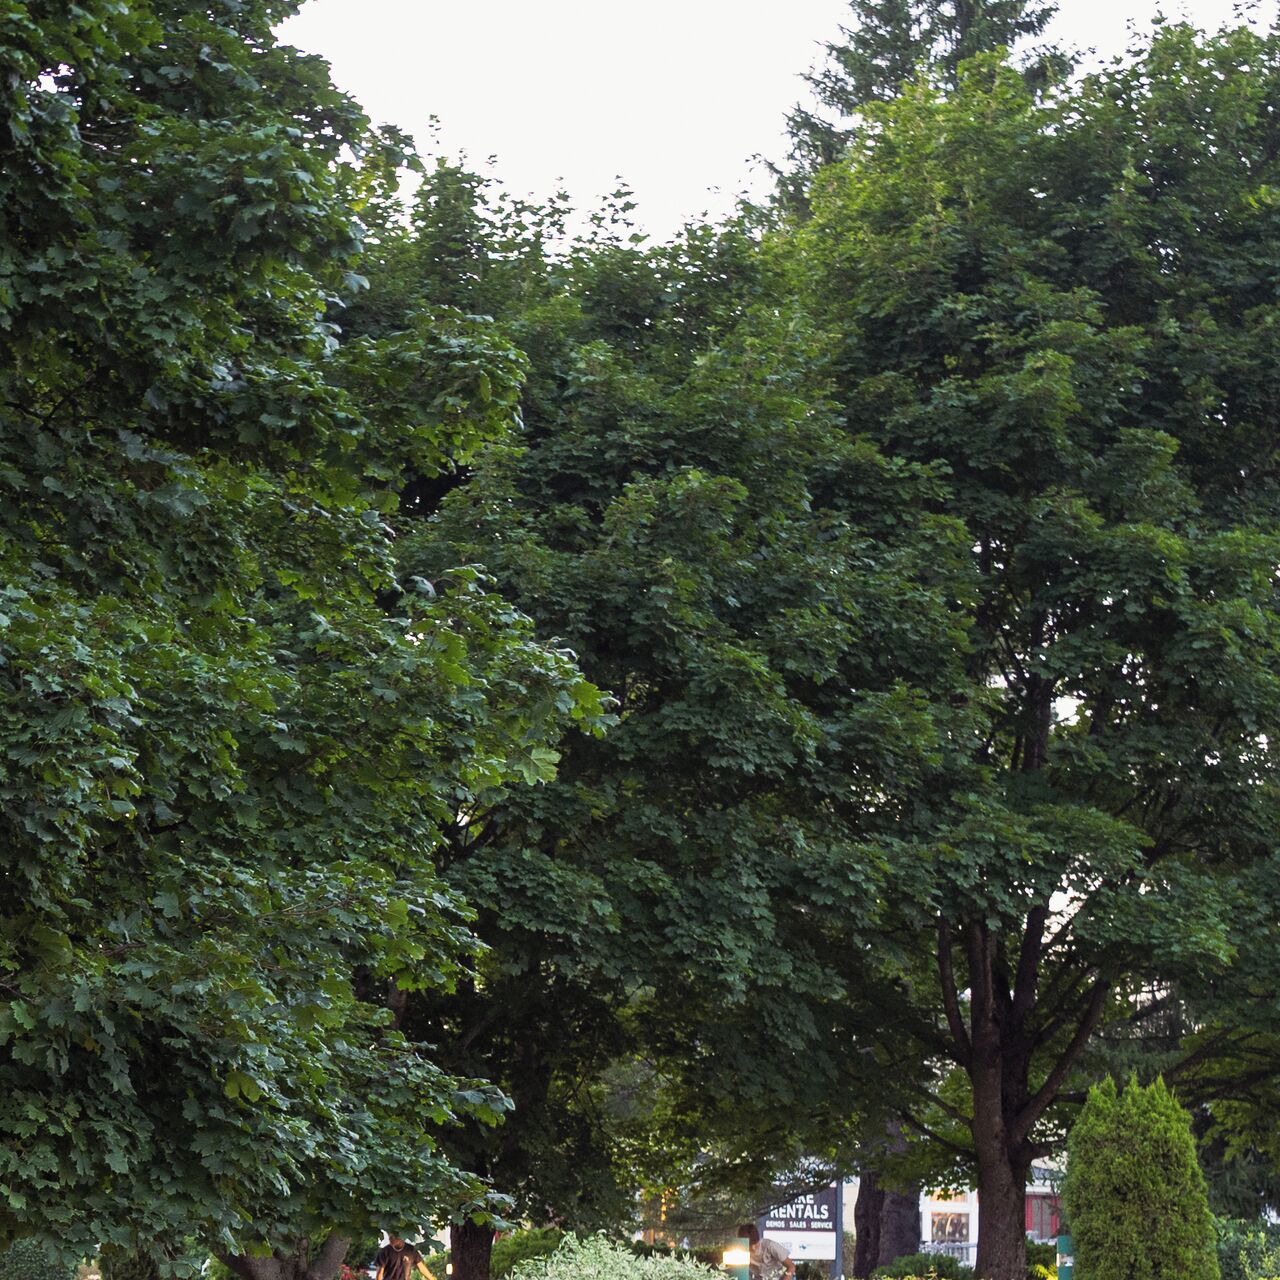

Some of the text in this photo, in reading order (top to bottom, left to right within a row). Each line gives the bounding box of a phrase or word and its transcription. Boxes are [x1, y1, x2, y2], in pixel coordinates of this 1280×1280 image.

[770, 1204, 829, 1219] RENTALS
[765, 1220, 833, 1229] DEMOS SALES SERVICE
